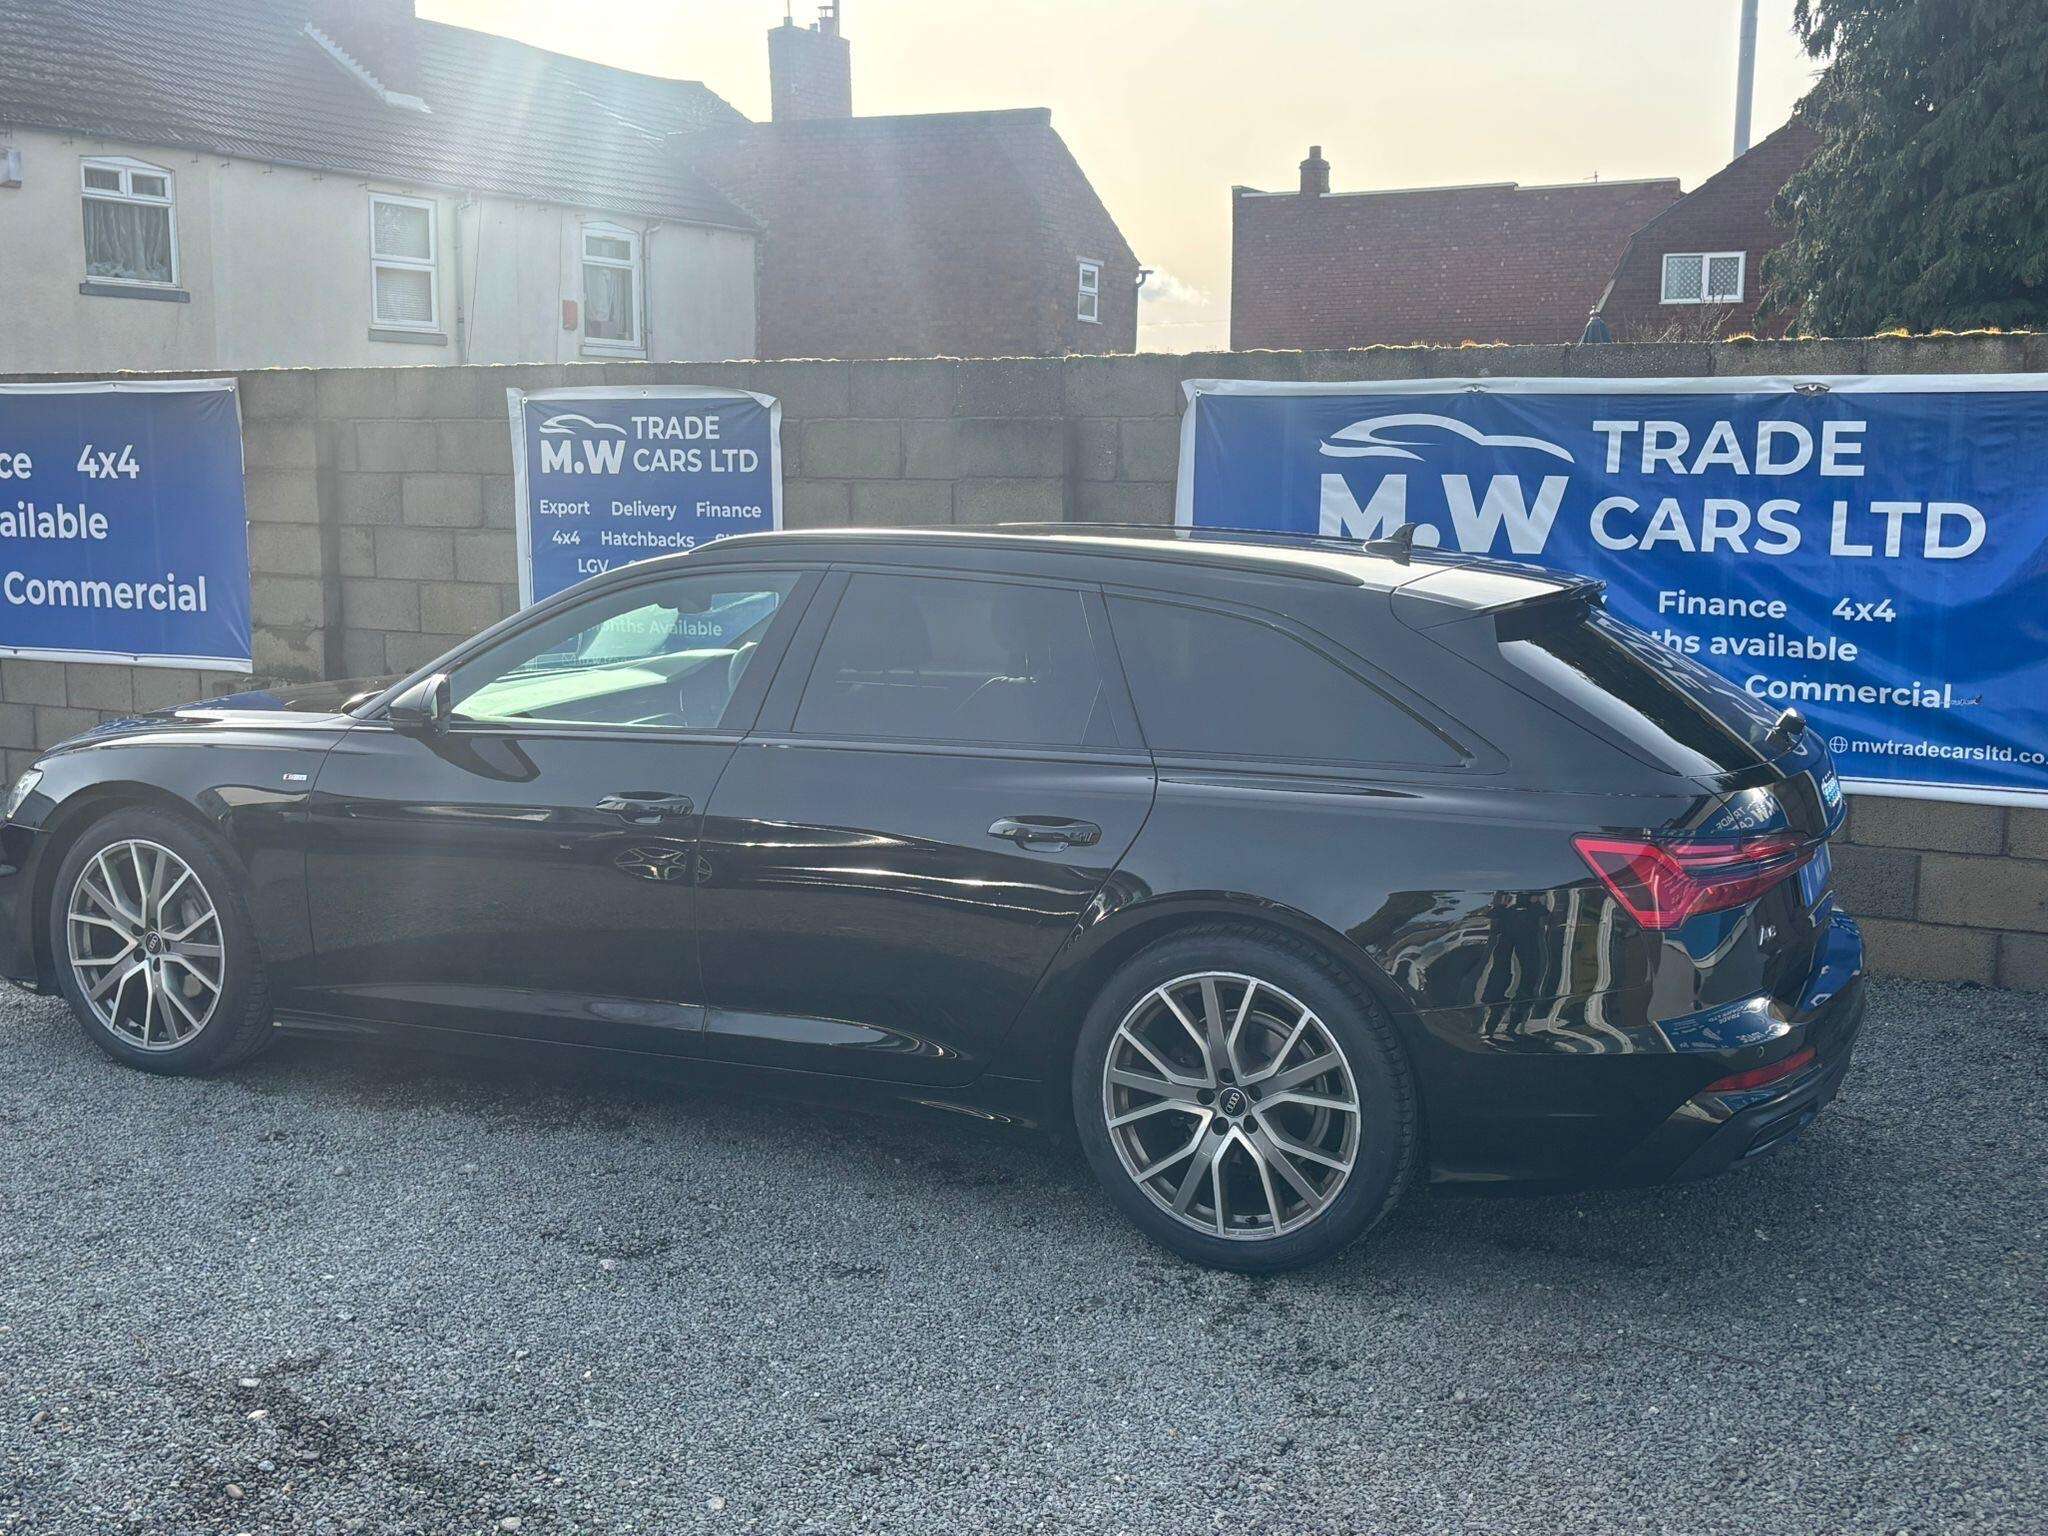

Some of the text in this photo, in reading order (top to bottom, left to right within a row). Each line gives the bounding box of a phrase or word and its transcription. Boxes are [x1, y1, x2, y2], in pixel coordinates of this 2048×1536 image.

[631, 416, 720, 439] TRADE
[77, 444, 140, 479] 4x4
[540, 440, 626, 474] M.W
[633, 449, 758, 473] CARS LTD
[1592, 420, 1868, 476] TRADE
[540, 500, 762, 520] Export Delivery Finance
[1319, 473, 1569, 554] M.W
[552, 530, 695, 547] 4x4 Hatchbacks
[1590, 496, 1988, 559] CARS LTD
[578, 558, 609, 574] LGV
[4, 571, 207, 612] Commercial
[1658, 589, 1897, 623] Finance 4x4
[649, 619, 722, 636] Available
[1709, 631, 1858, 662] available
[1744, 674, 1951, 709] Commercial
